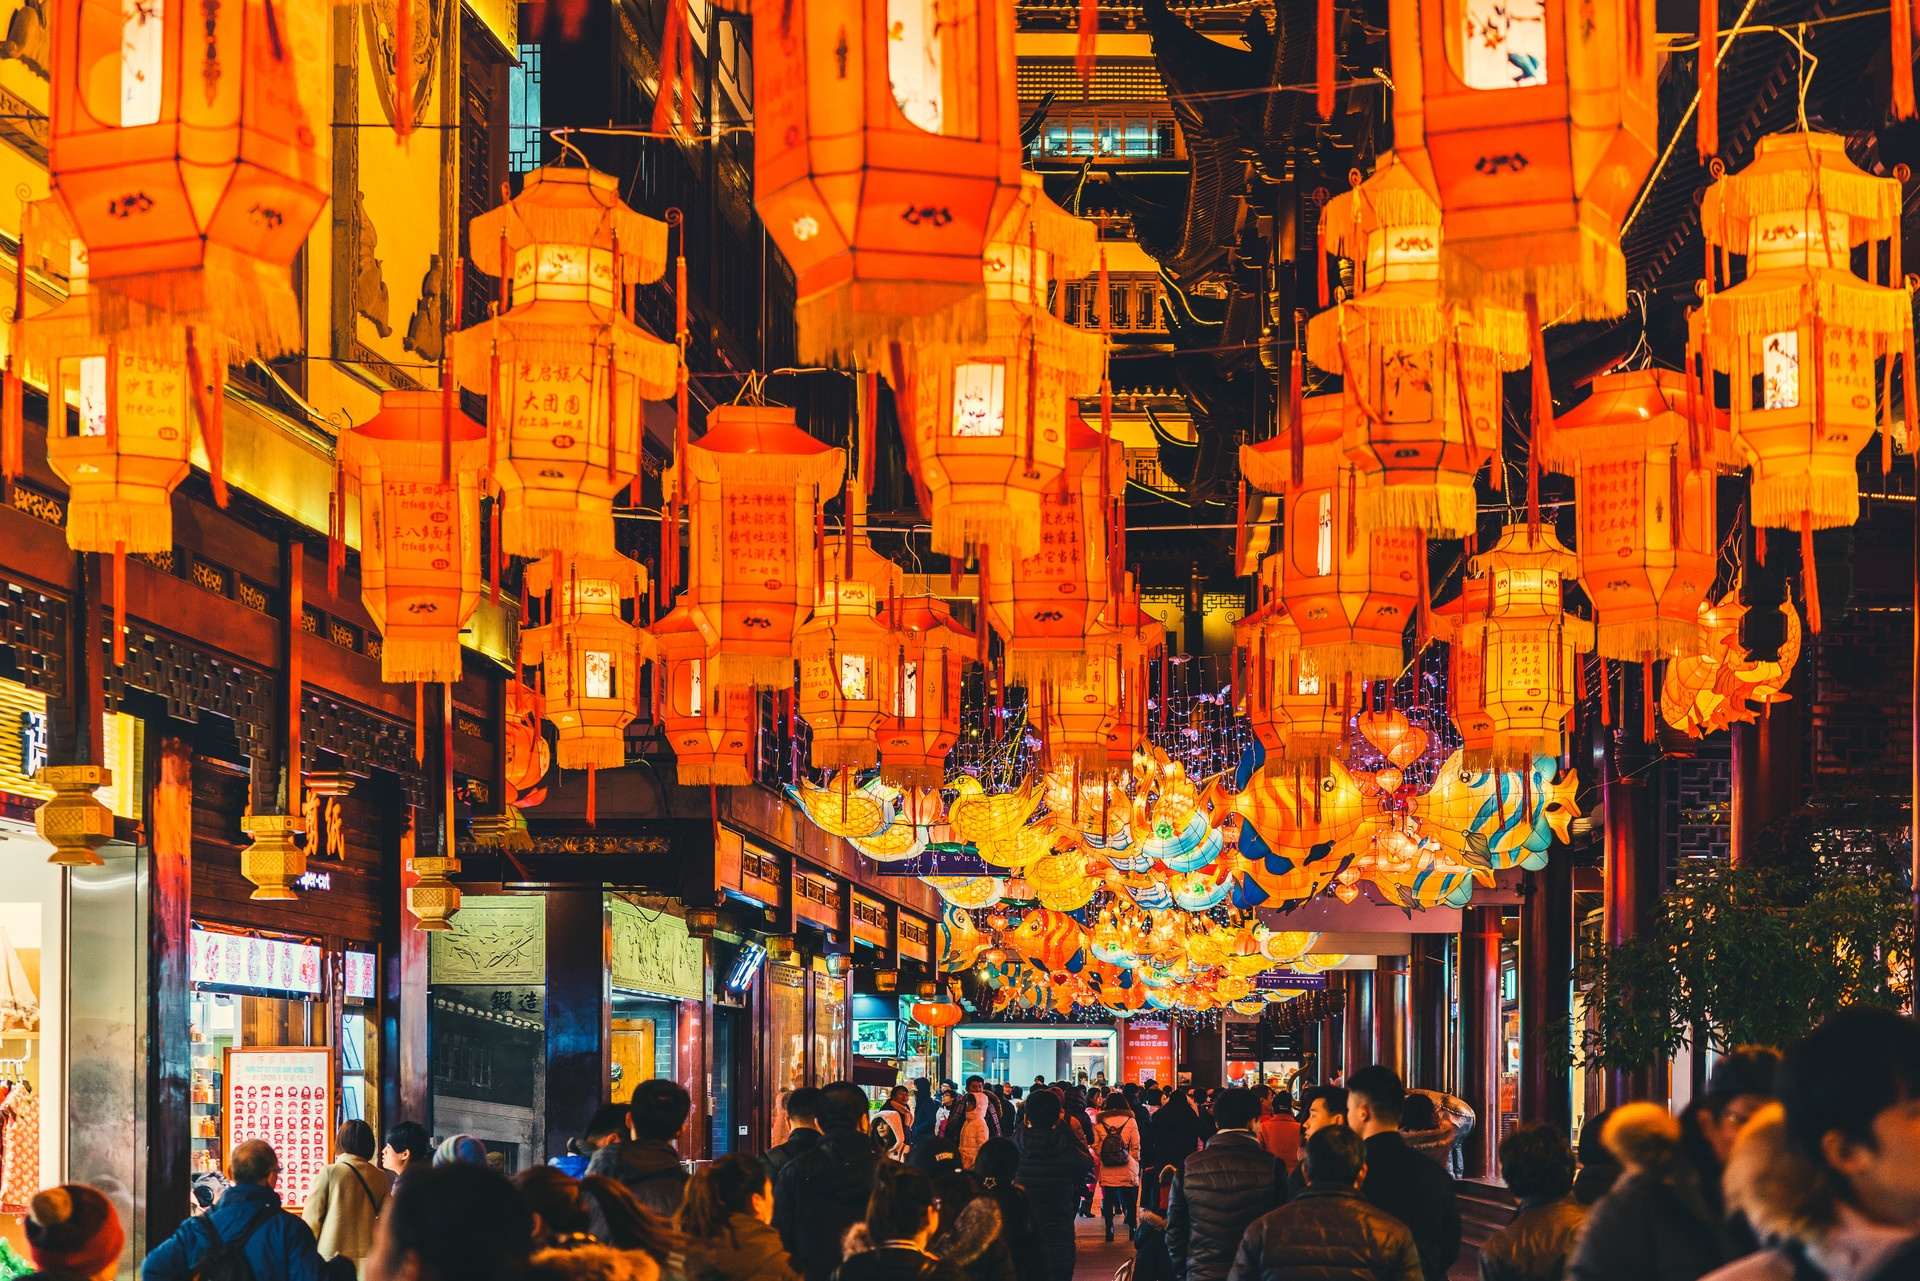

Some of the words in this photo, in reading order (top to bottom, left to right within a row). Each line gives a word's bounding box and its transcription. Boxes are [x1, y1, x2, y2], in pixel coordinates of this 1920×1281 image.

[522, 390, 580, 415] 大团圆
[392, 525, 454, 541] 三八多面手
[1507, 678, 1540, 686] 打一动物
[491, 990, 540, 1013] 鍛造
